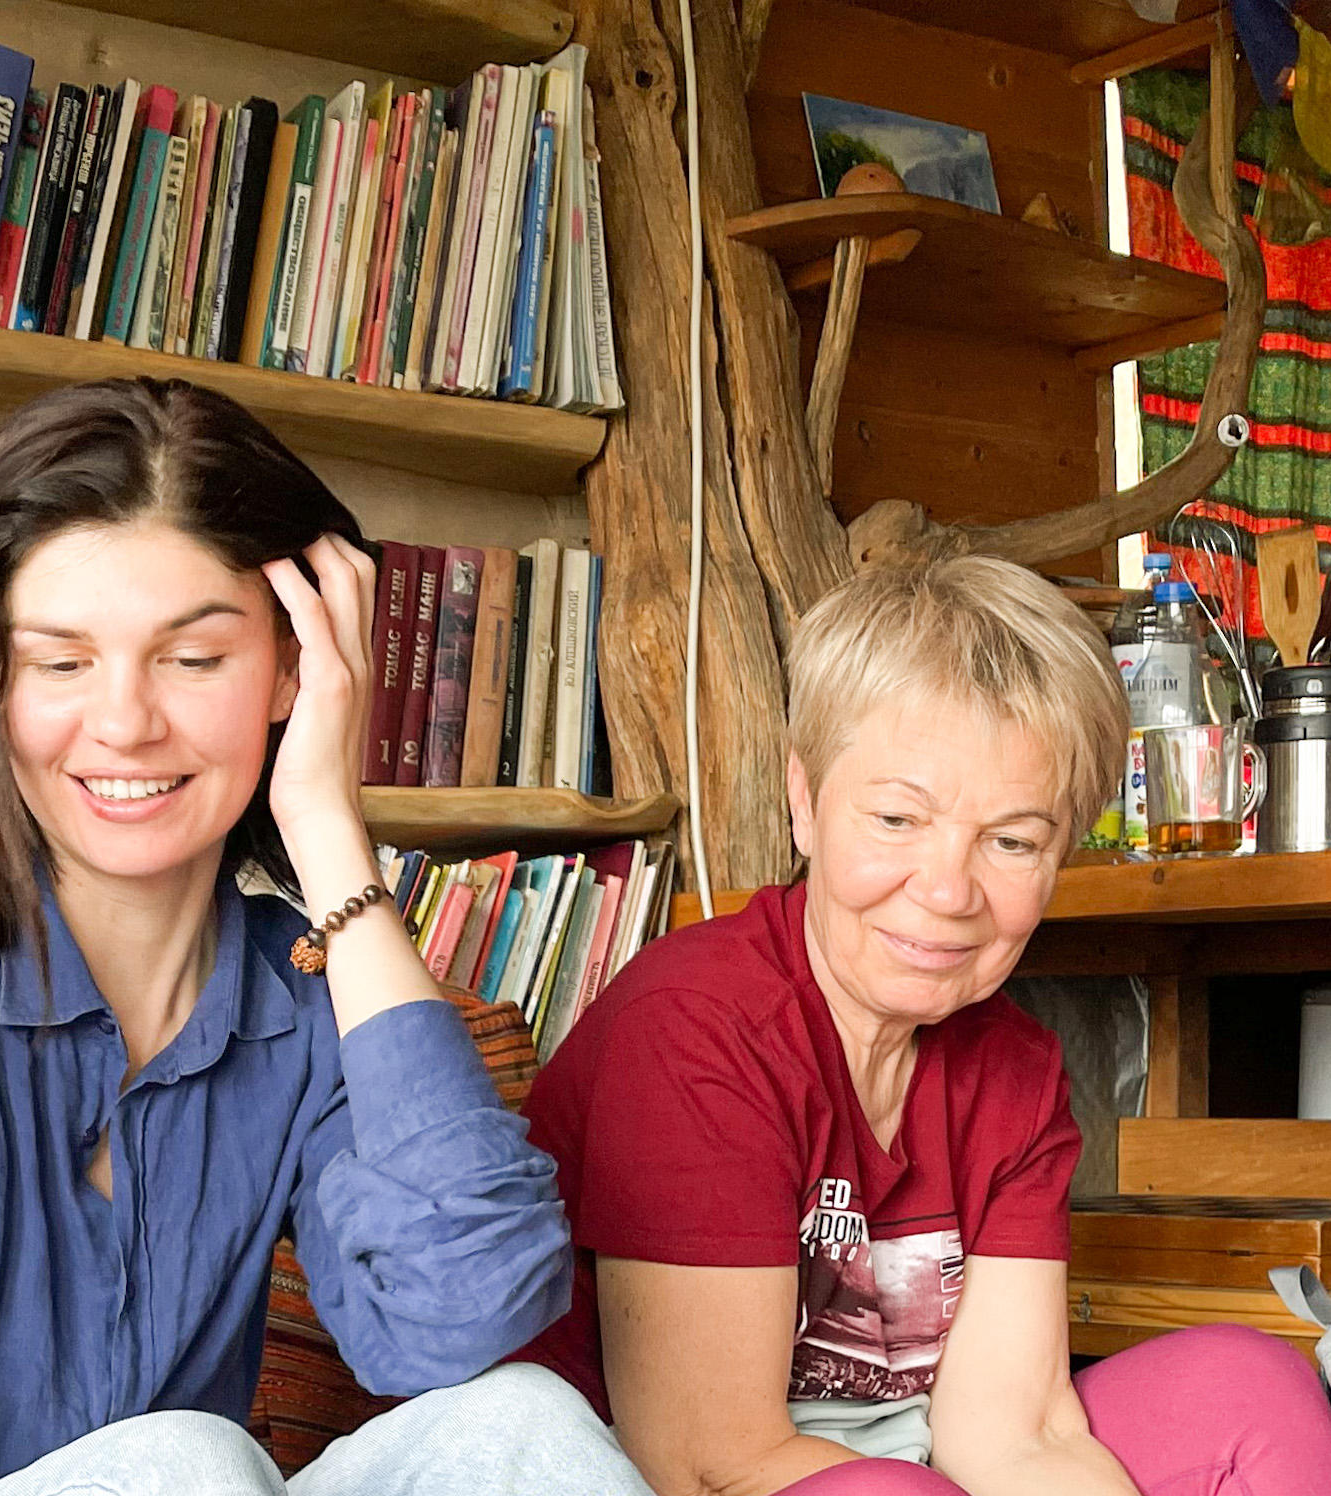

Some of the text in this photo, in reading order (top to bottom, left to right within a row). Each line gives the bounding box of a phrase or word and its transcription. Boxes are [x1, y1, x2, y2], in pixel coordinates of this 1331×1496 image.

[279, 195, 308, 334] ОБЩЕСТВОЗНАНИЕ
[599, 318, 615, 381] ДЕТСКАЯ
[411, 571, 437, 691] ТОМАС МАНН
[384, 628, 401, 689] ТОМАС
[379, 739, 390, 765] 1
[402, 740, 419, 765] 2
[502, 761, 511, 777] 2
[813, 1213, 863, 1244] DOM
